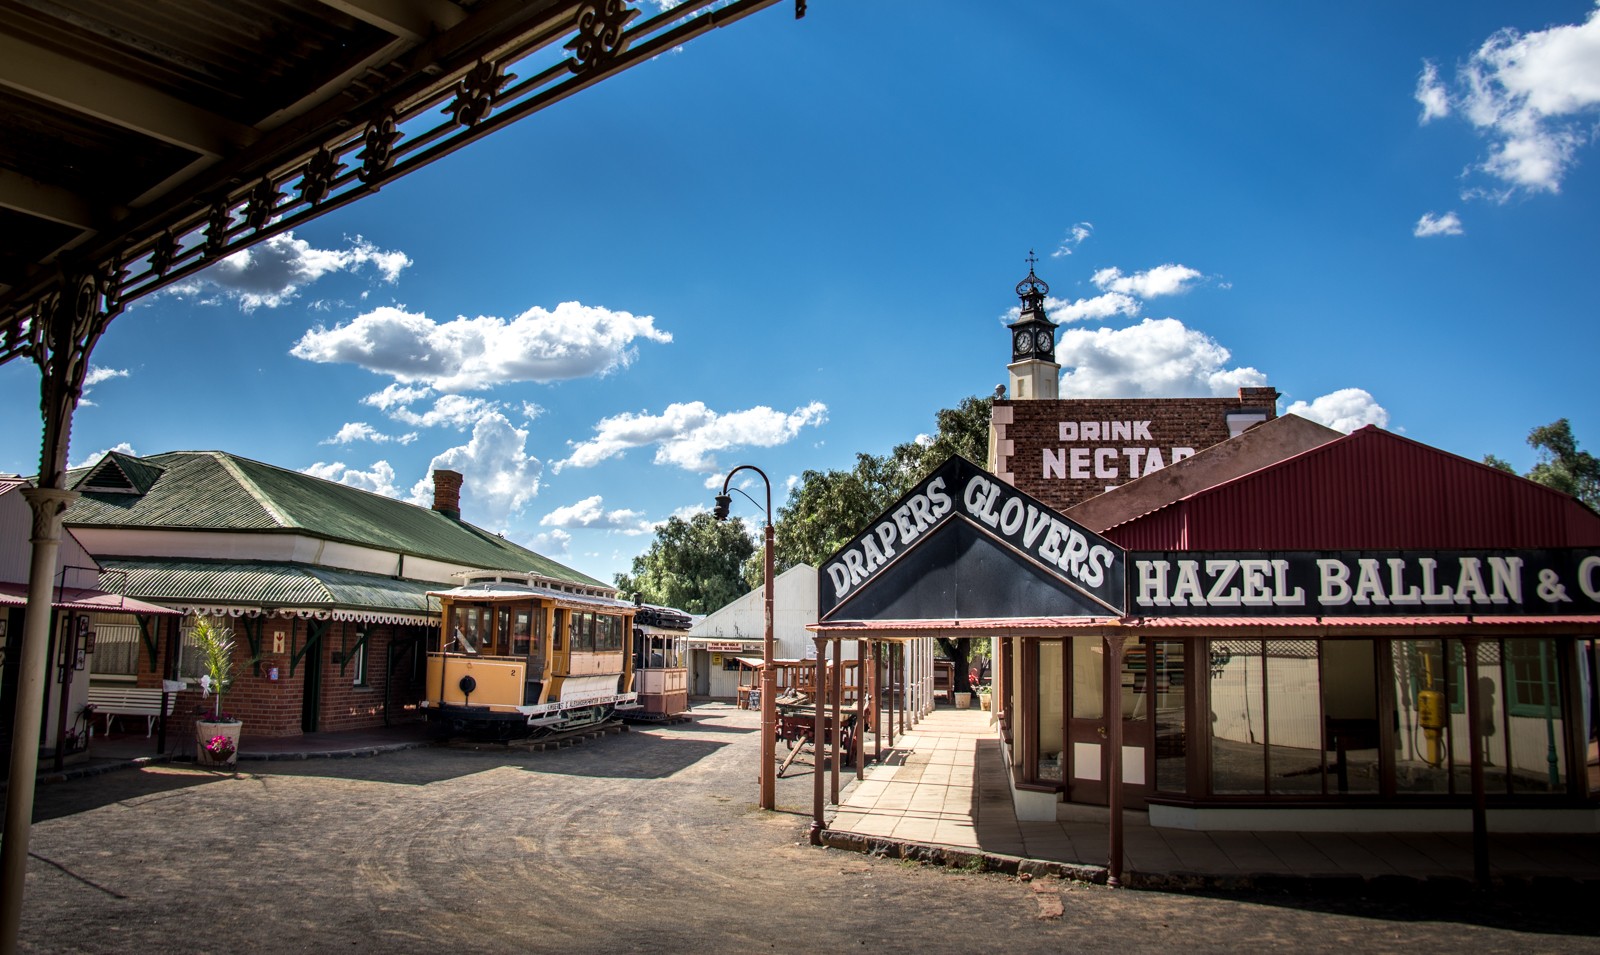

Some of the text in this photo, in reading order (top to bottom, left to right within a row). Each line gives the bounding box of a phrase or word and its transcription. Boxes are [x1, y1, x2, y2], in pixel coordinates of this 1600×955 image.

[1059, 421, 1153, 441] DRINK
[827, 475, 1115, 598] DRAPERS GLOVERS
[1135, 559, 1306, 607] HAZEL
[1316, 556, 1524, 606] BALLAN
[1536, 568, 1574, 603] &
